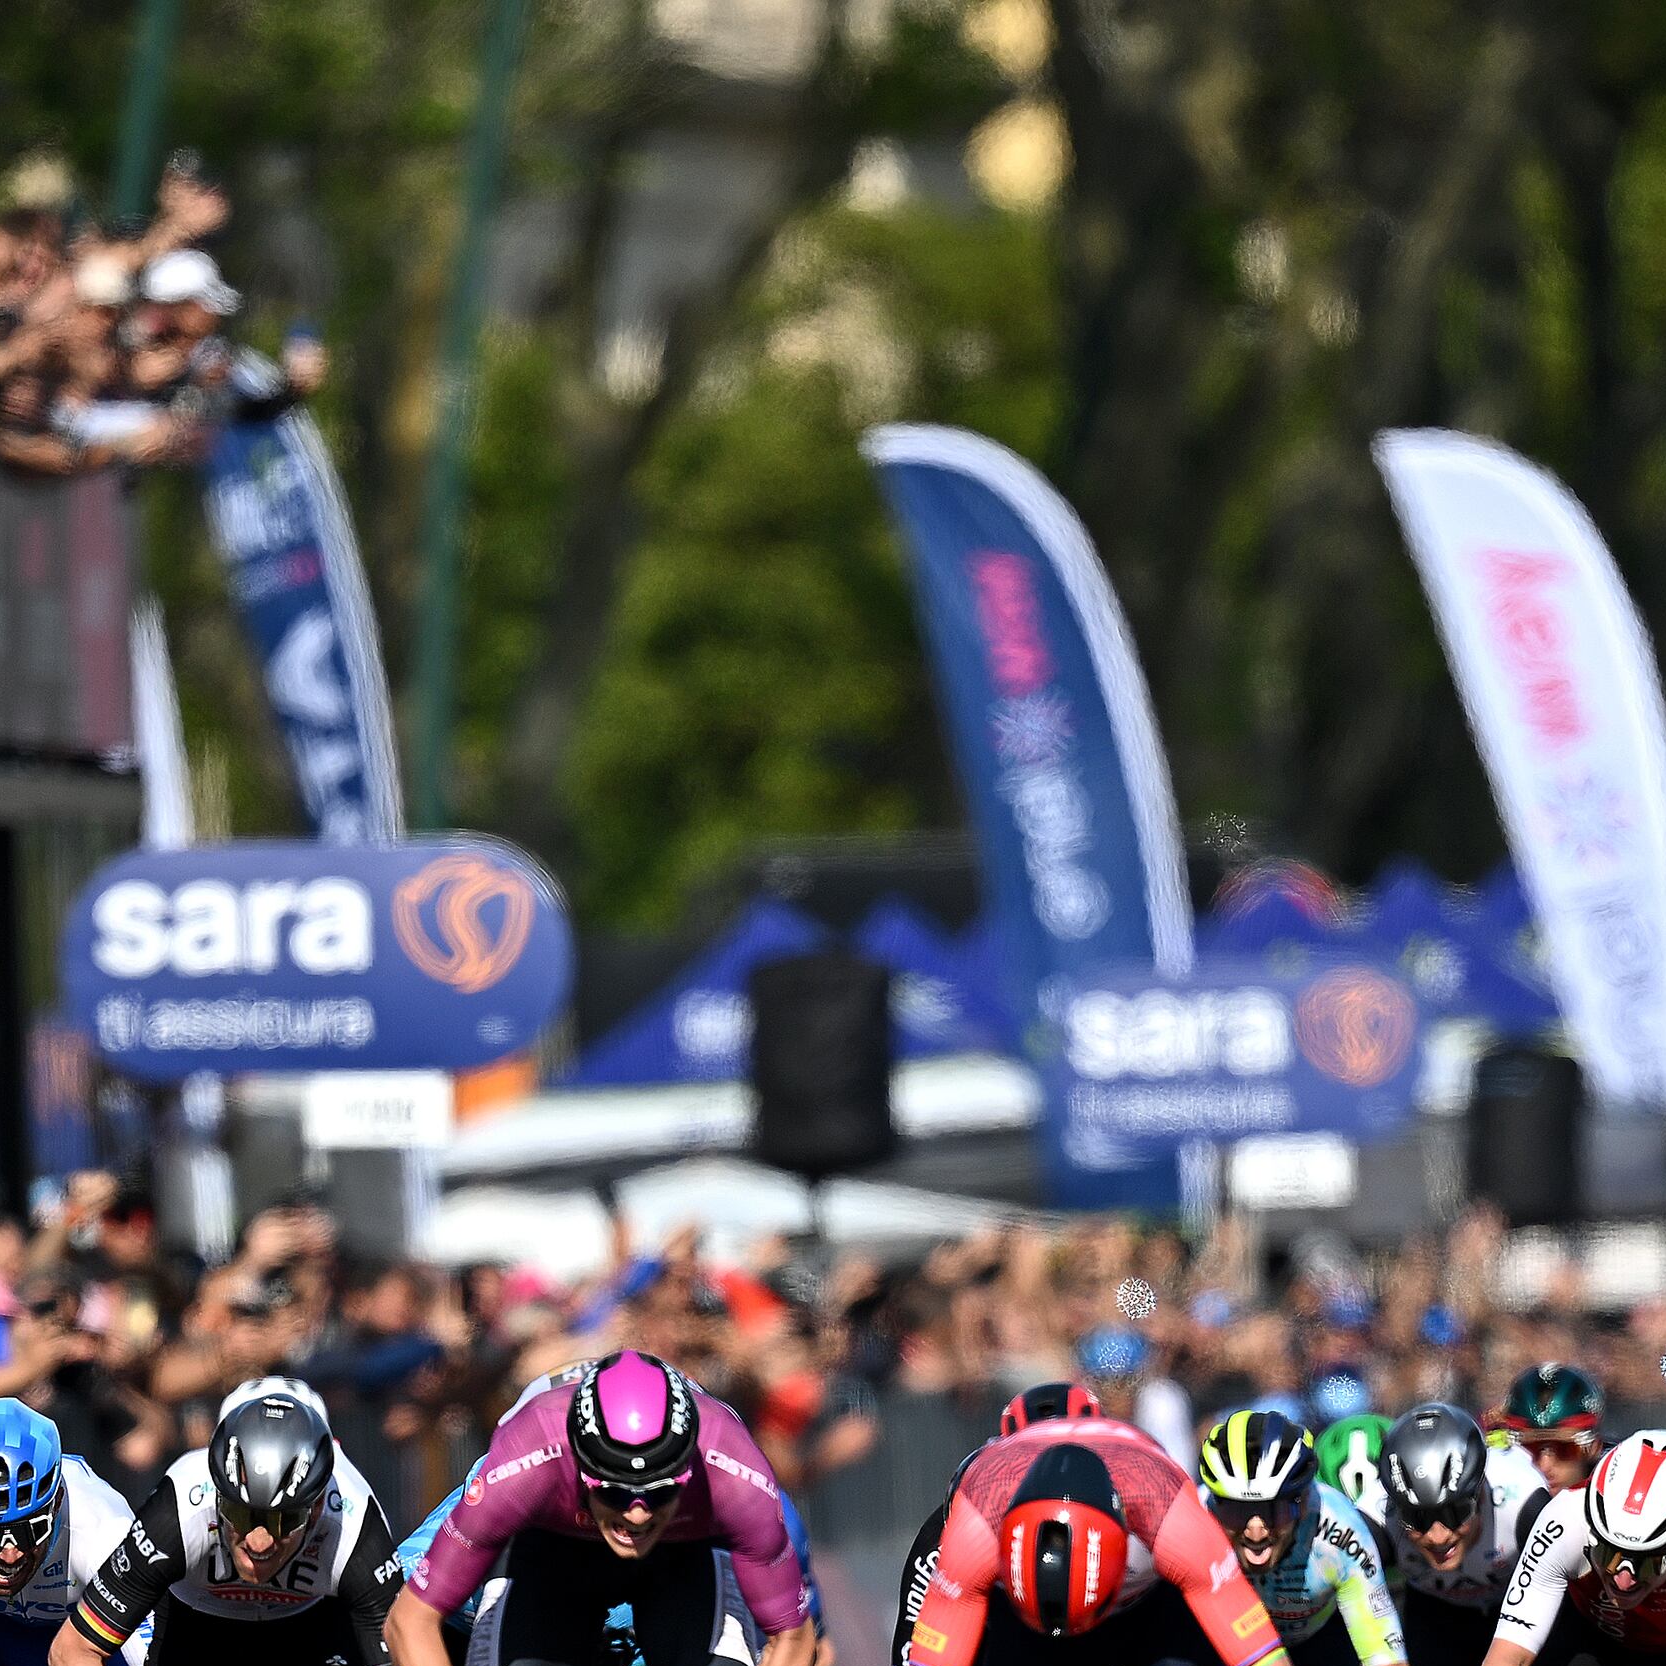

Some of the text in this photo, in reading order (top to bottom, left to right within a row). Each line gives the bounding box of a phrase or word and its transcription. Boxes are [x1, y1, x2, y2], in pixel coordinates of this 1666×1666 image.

[91, 877, 374, 978] sara
[1066, 986, 1294, 1080] sara
[1507, 1519, 1565, 1607] Cofidis
